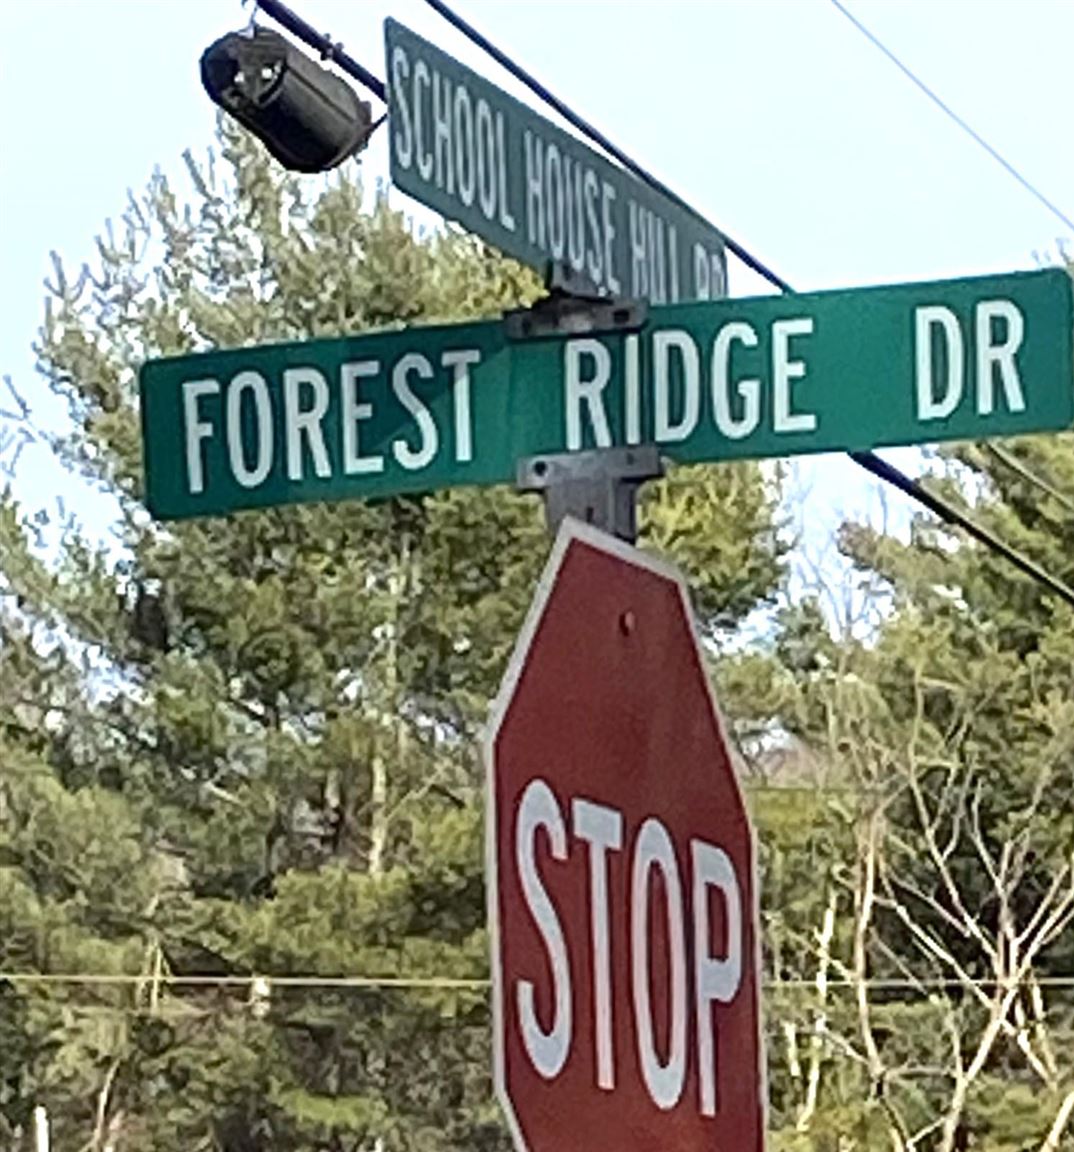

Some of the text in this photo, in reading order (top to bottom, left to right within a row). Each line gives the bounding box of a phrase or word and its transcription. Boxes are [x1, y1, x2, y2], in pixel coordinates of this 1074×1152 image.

[392, 47, 515, 232] SCHOOL
[523, 130, 621, 298] HOUSE
[629, 201, 680, 305] HILL
[181, 300, 1025, 493] FOREST RIDGE DR
[516, 779, 742, 1118] STOP
